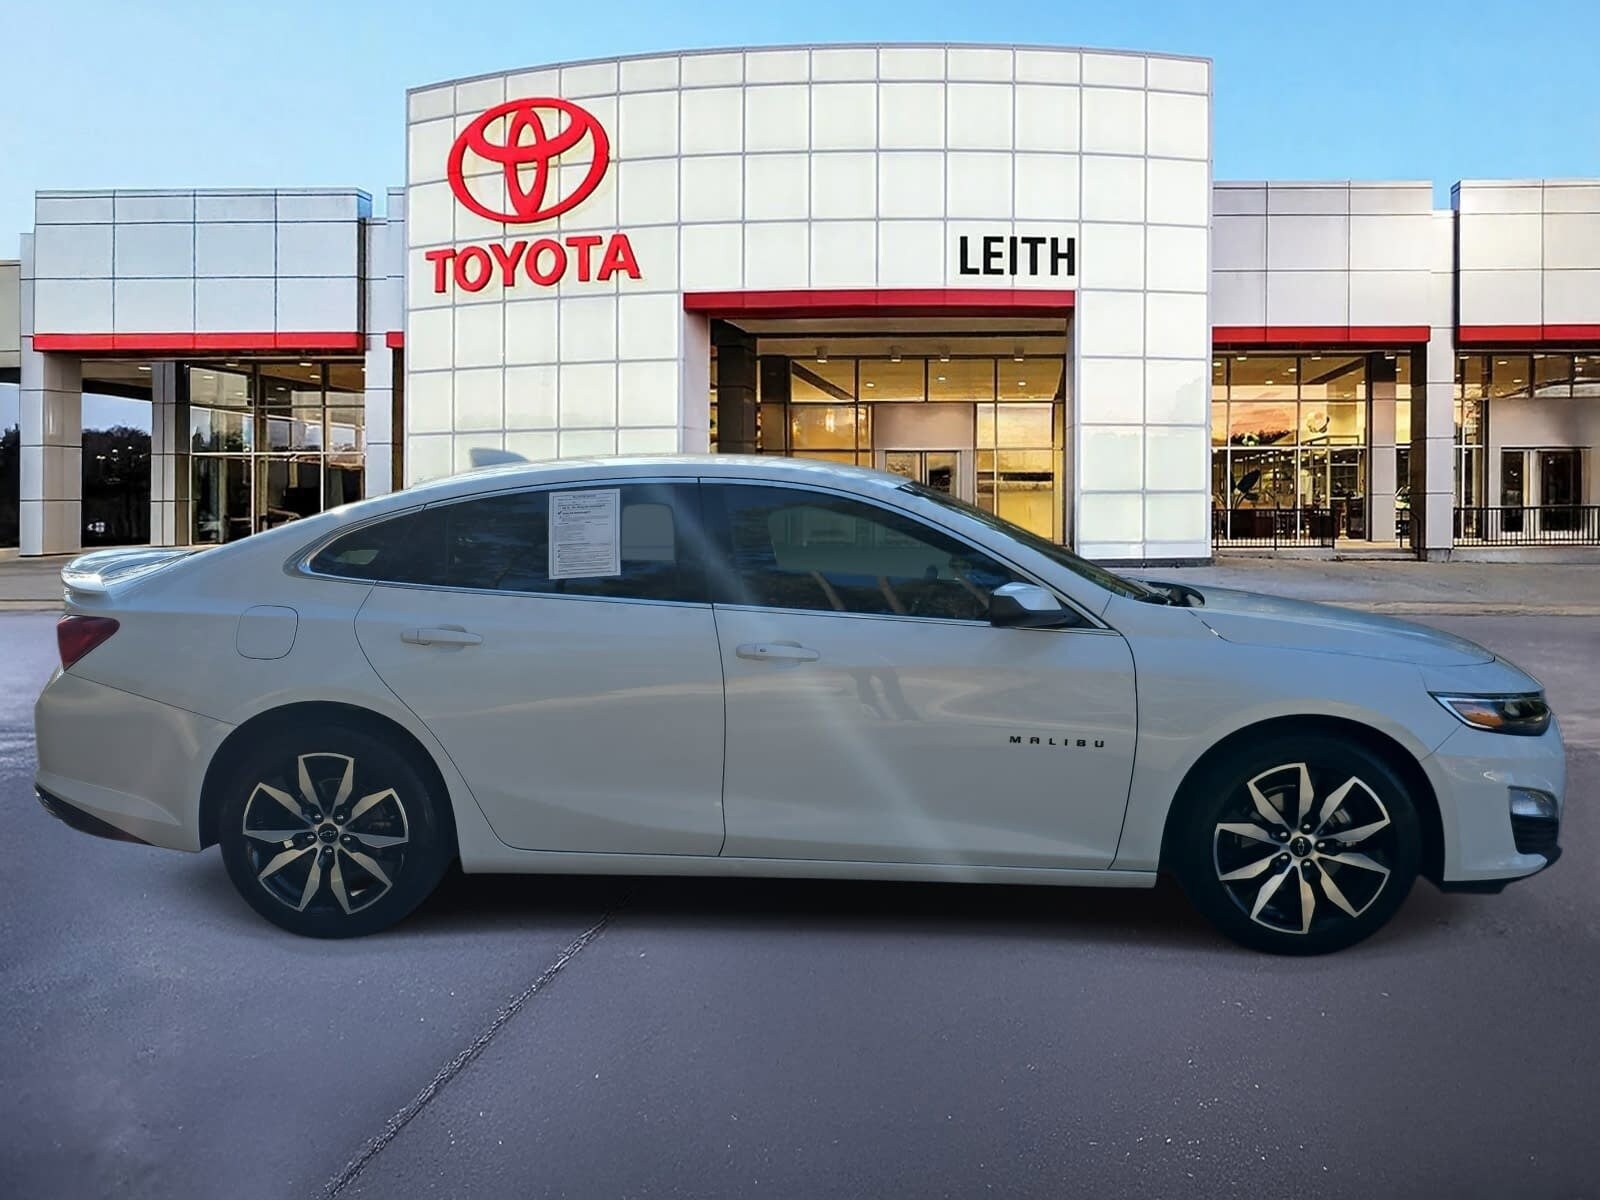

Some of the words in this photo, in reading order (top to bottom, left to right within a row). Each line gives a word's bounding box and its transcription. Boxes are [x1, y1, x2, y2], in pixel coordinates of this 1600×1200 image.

[426, 233, 641, 293] TOYOTA
[959, 236, 1076, 276] LEITH
[1009, 735, 1105, 748] MALIBU
